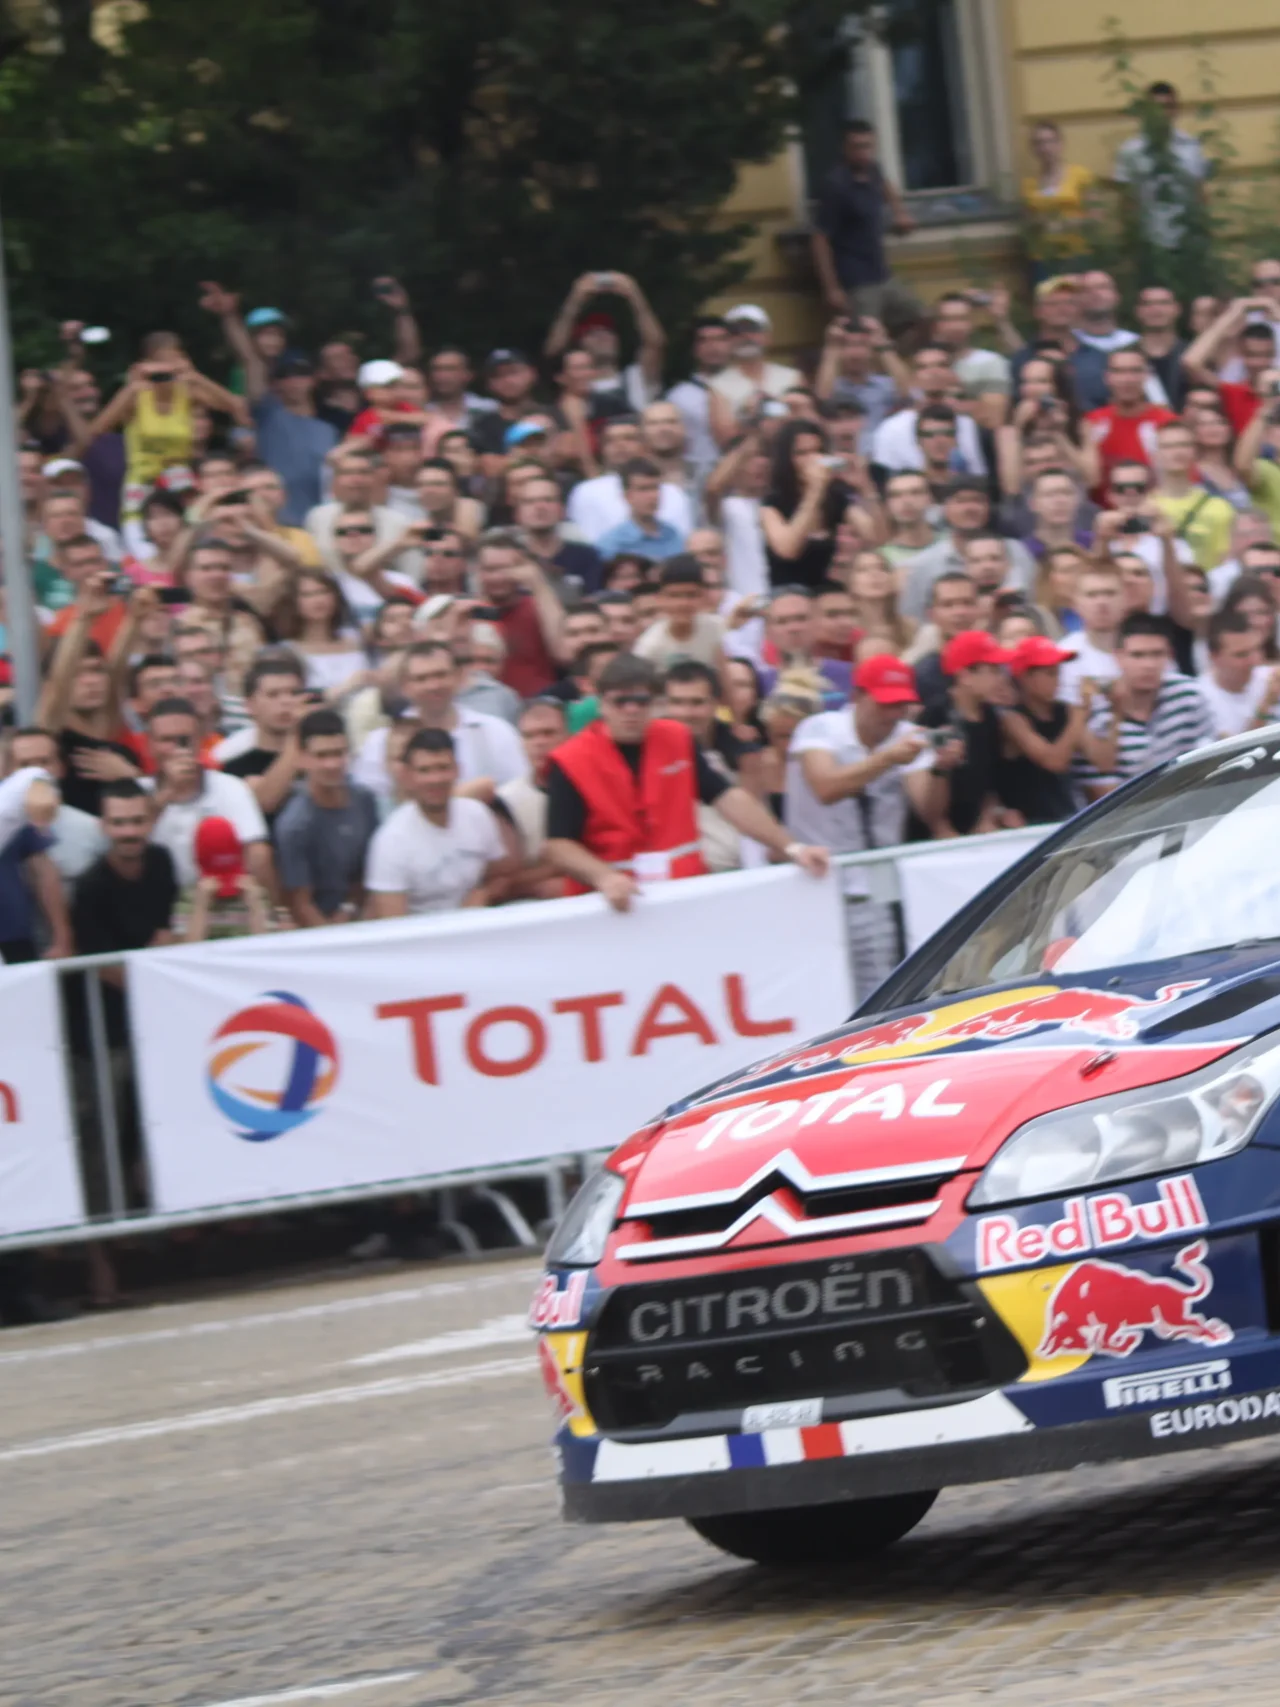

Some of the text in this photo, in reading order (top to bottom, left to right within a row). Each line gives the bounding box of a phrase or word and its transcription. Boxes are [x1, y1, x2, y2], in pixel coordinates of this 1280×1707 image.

[375, 972, 794, 1086] TOTAL
[695, 1079, 967, 1150] TOTAL
[976, 1173, 1209, 1272] Red Bull
[629, 1261, 913, 1342] CITROËN
[1102, 1358, 1232, 1409] PIRELLI
